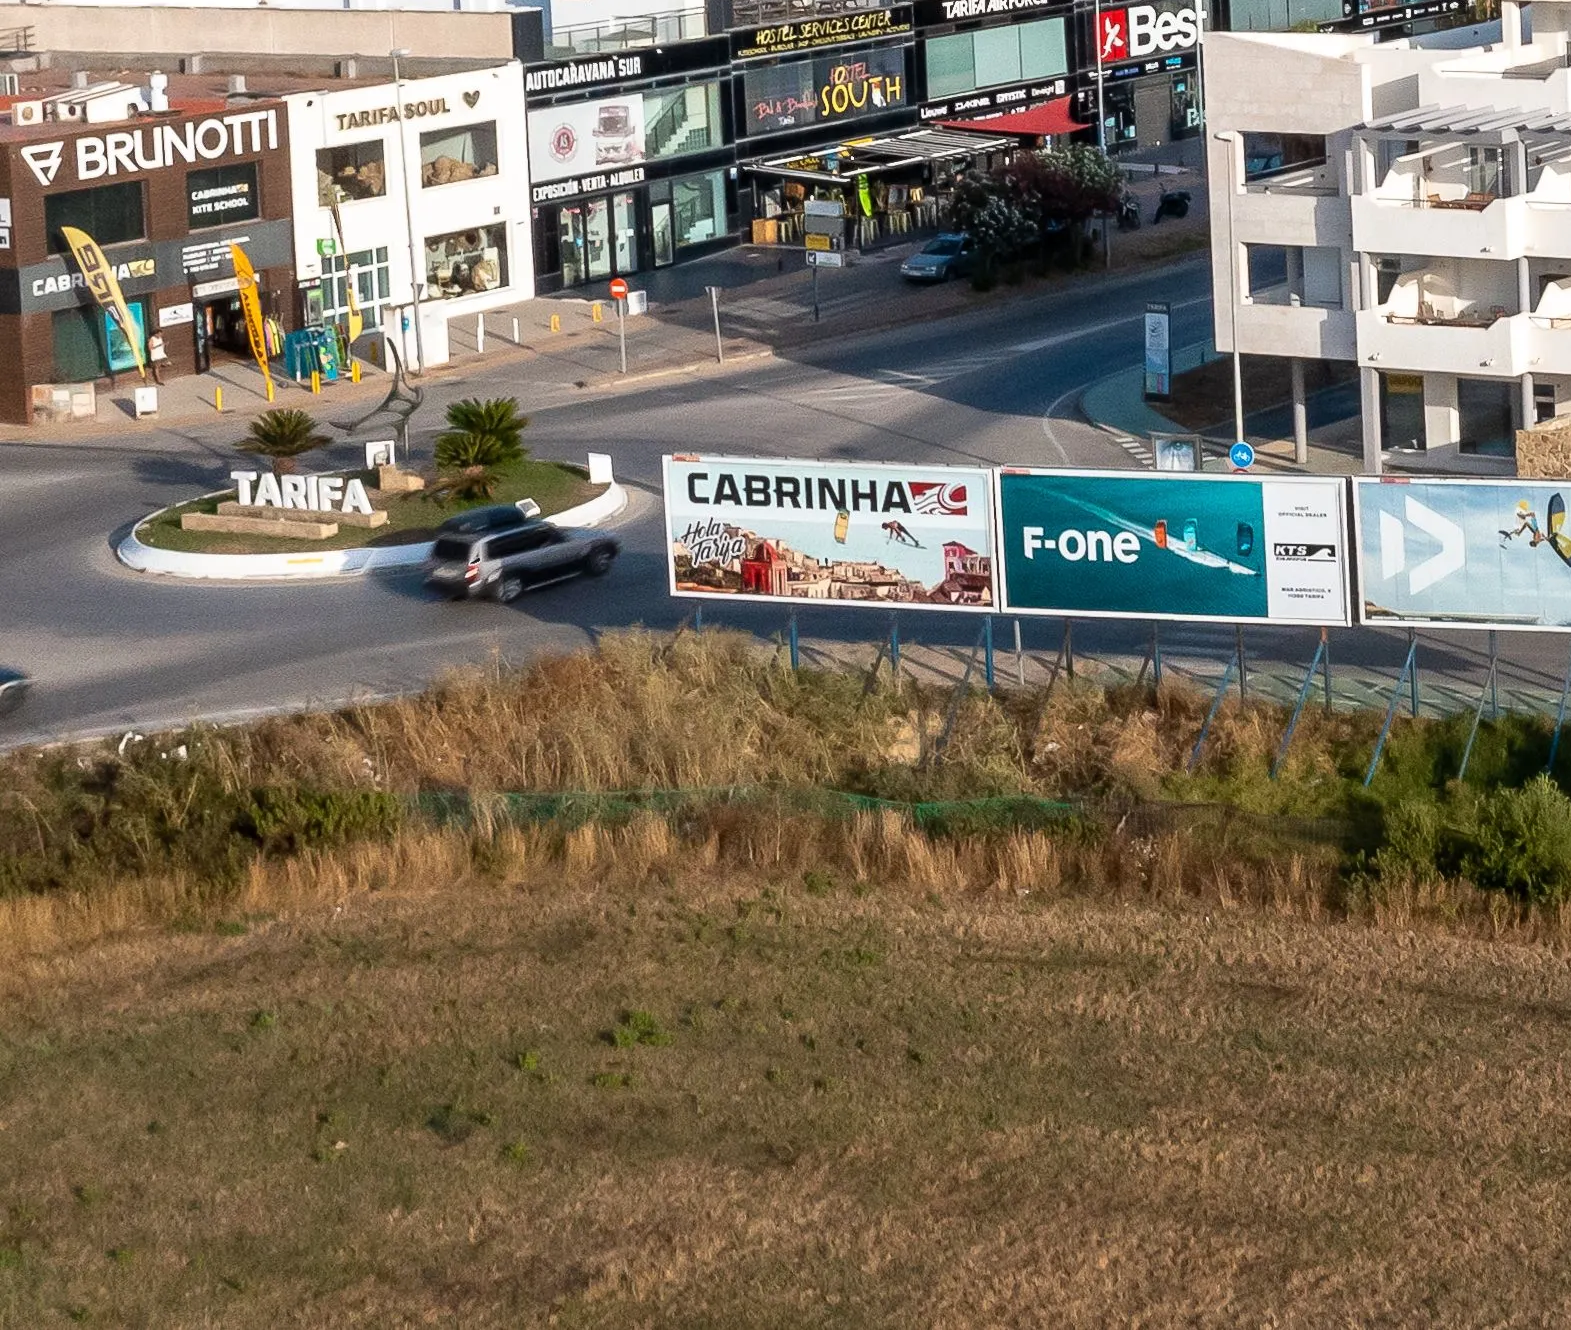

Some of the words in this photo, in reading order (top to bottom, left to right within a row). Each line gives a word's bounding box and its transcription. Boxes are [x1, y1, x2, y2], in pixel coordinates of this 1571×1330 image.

[756, 25, 798, 46] HOSTEL
[800, 16, 850, 39] SERVICES
[851, 10, 893, 31] CENTER
[525, 59, 616, 91] AUTOCARAVANA
[618, 56, 642, 77] SUR
[336, 106, 401, 131] TARIFA
[403, 97, 451, 120] SOUL
[76, 109, 279, 181] BRUNOTTI
[581, 174, 607, 192] VENTA
[213, 197, 249, 211] SCHOOL
[230, 471, 374, 515] TARIFA
[687, 471, 912, 514] CABRINHA
[680, 516, 721, 544] Hola
[1022, 526, 1141, 564] F-one
[1275, 545, 1308, 556] KTS
